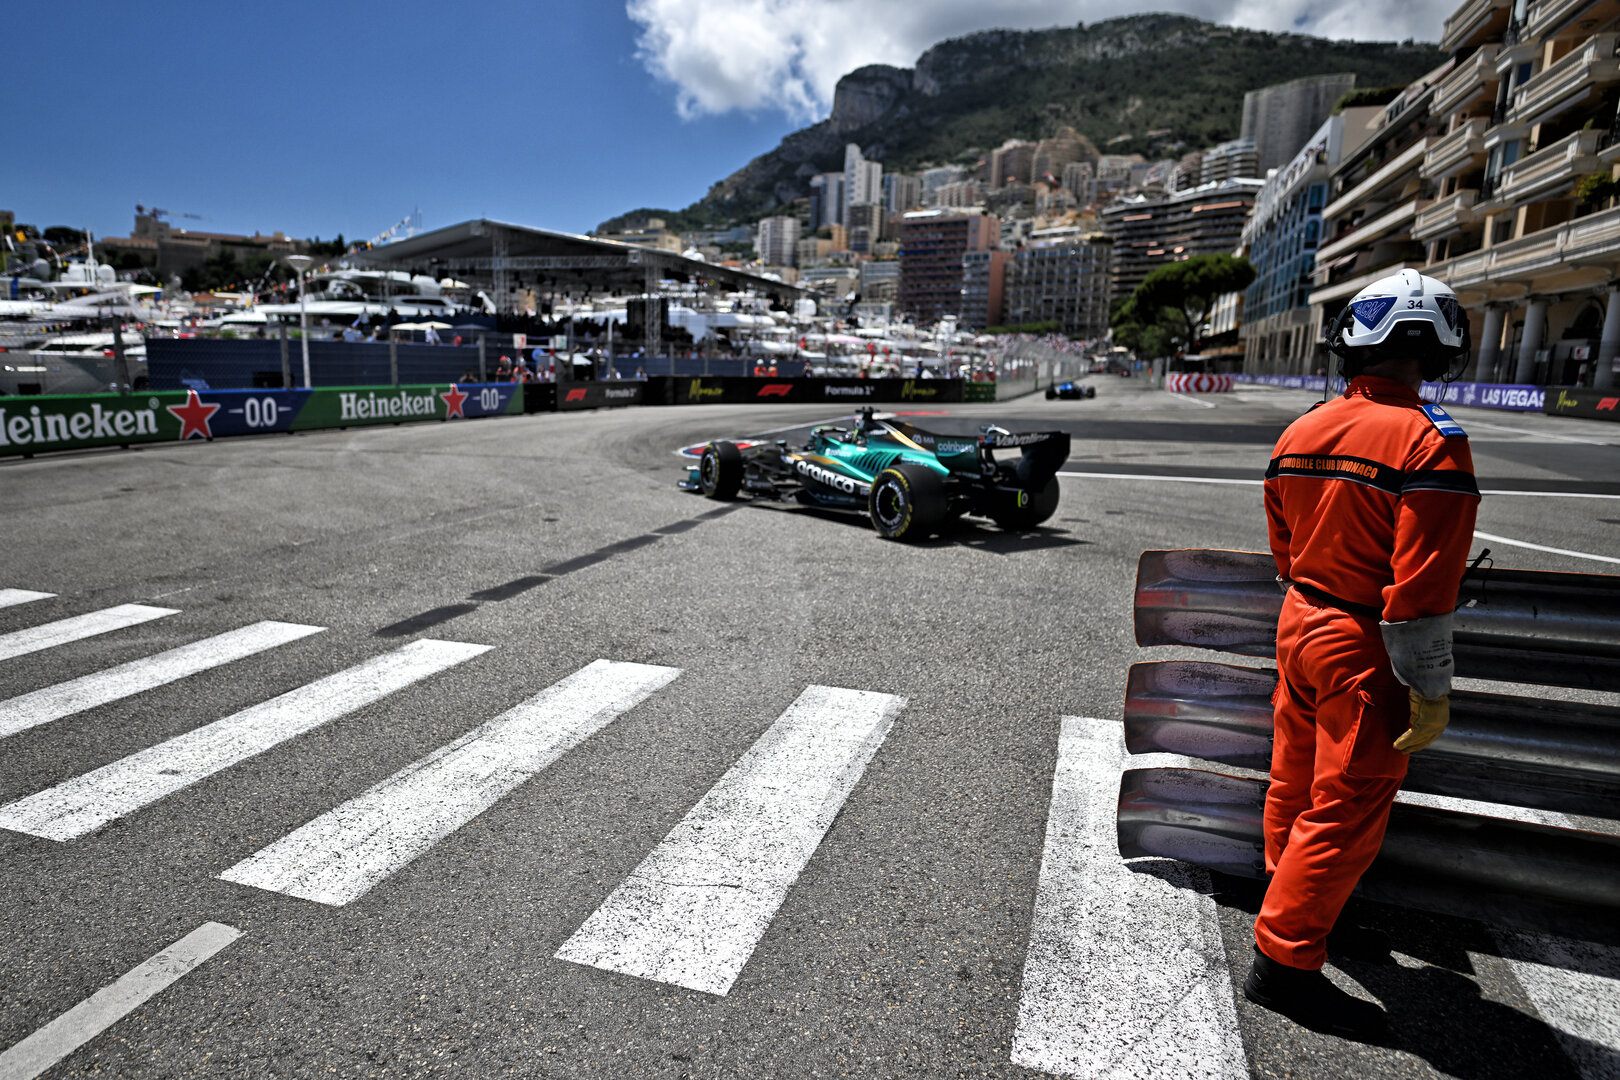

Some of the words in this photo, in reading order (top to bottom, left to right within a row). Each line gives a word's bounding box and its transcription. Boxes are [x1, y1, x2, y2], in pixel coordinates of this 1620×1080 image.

[1407, 299, 1424, 310] 34
[480, 388, 499, 411] 0.0
[824, 385, 863, 396] Formula
[1481, 388, 1500, 405] LAS
[244, 396, 278, 427] 0.0
[339, 390, 436, 420] Heineken
[1315, 458, 1336, 471] CLUB
[796, 460, 856, 494] aramco
